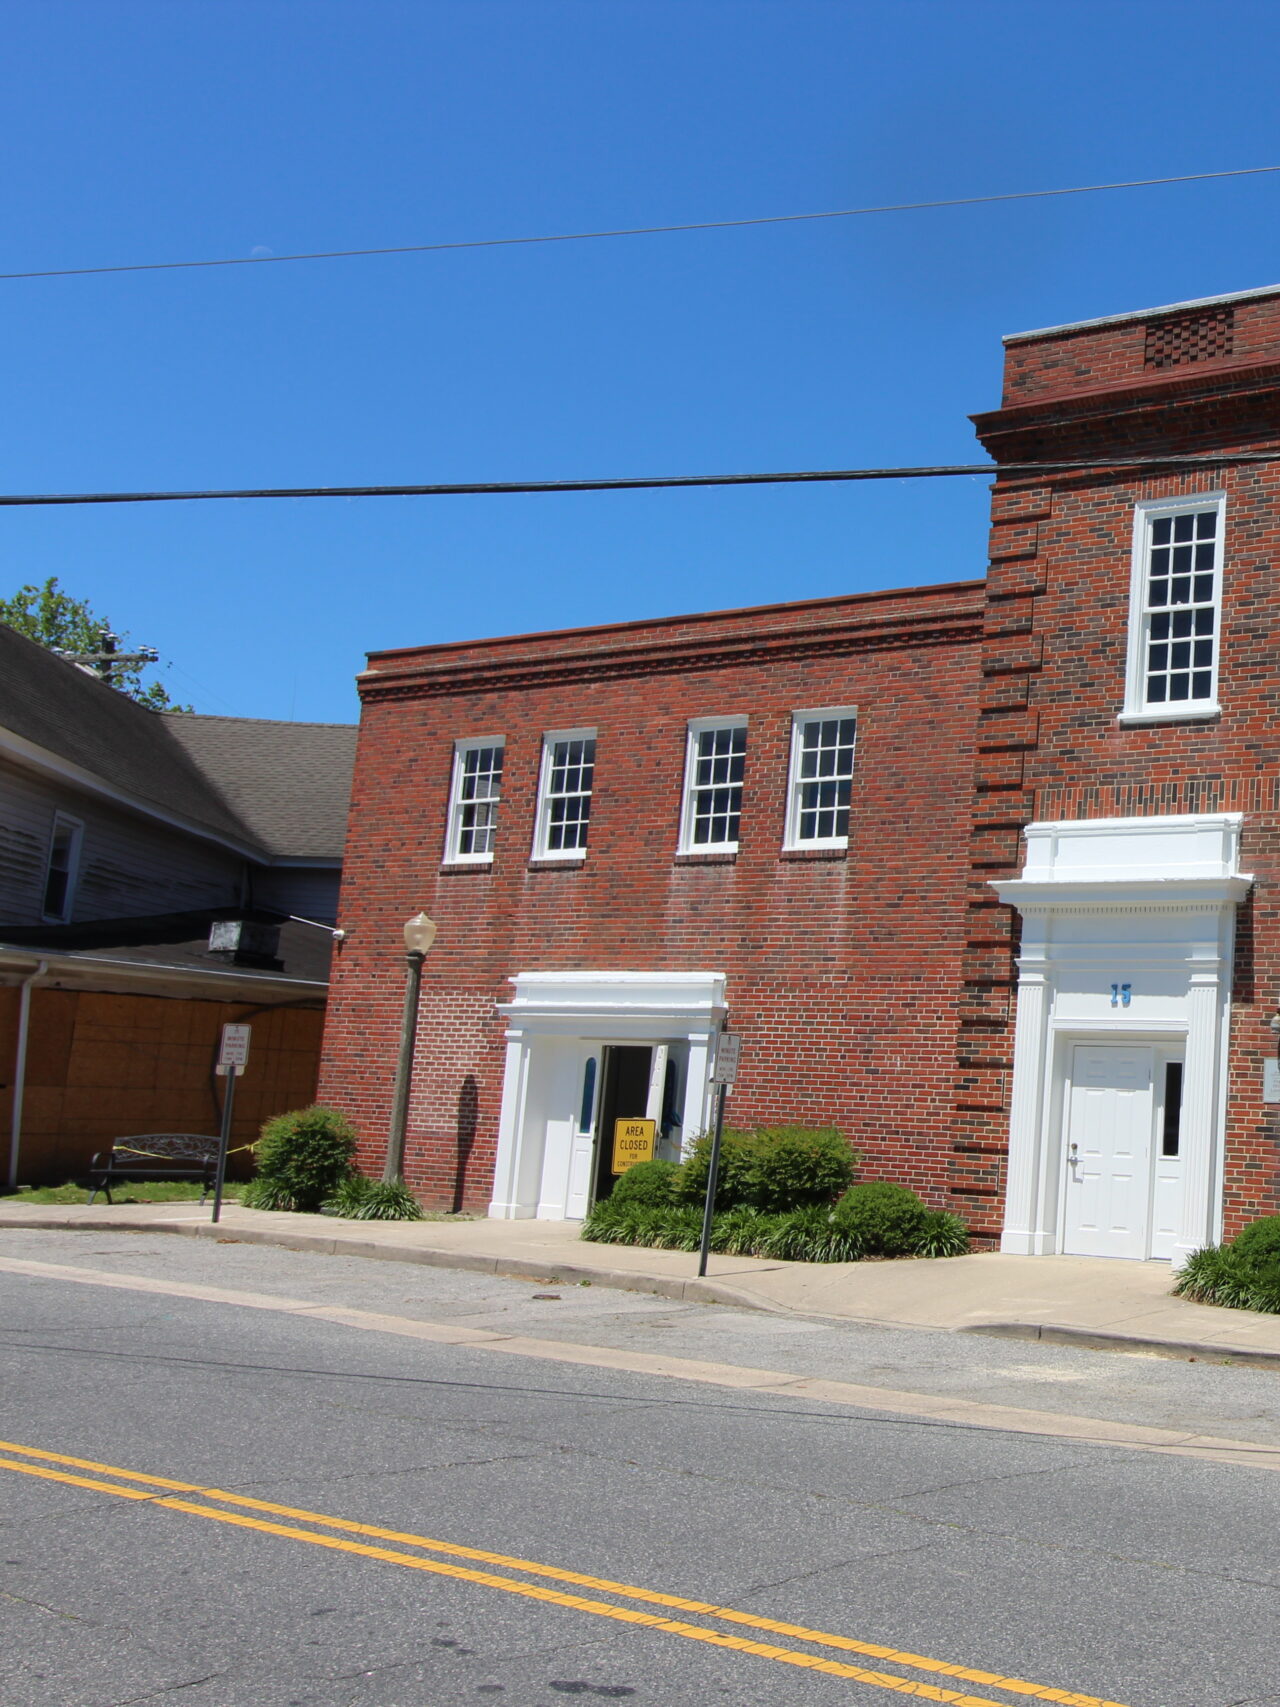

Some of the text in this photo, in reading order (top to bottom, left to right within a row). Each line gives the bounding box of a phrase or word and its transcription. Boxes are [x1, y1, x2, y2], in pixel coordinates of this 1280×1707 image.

[1111, 984, 1131, 1004] 15
[625, 1126, 644, 1136] AREA
[620, 1140, 648, 1150] CLOSED
